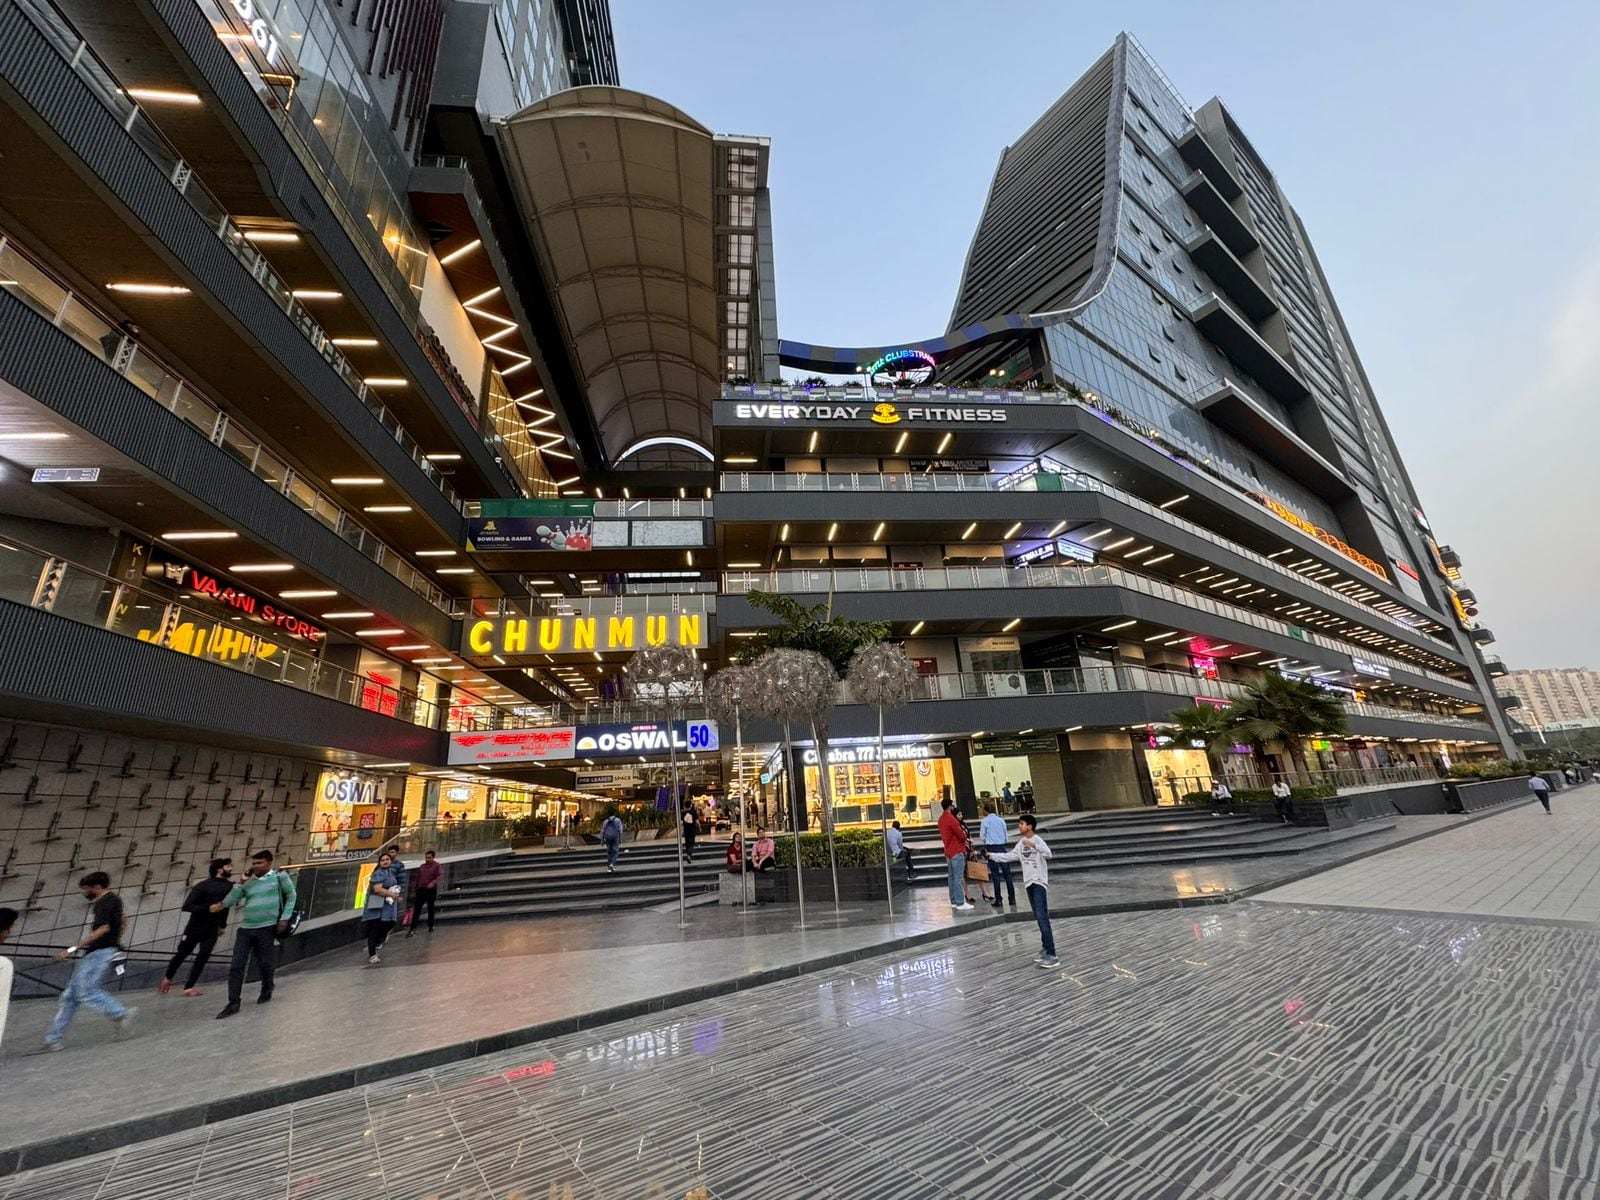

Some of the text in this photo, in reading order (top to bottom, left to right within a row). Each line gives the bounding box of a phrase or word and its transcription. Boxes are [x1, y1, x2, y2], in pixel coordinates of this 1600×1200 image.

[736, 403, 1007, 422] EVERYDAY FITNESS
[191, 570, 256, 614] VAANI
[262, 604, 320, 642] STORE
[470, 615, 699, 653] CHUNMUN
[598, 730, 687, 751] OSWAL
[690, 724, 709, 748] 50
[856, 746, 874, 761] 777
[324, 779, 383, 803] OSWAL
